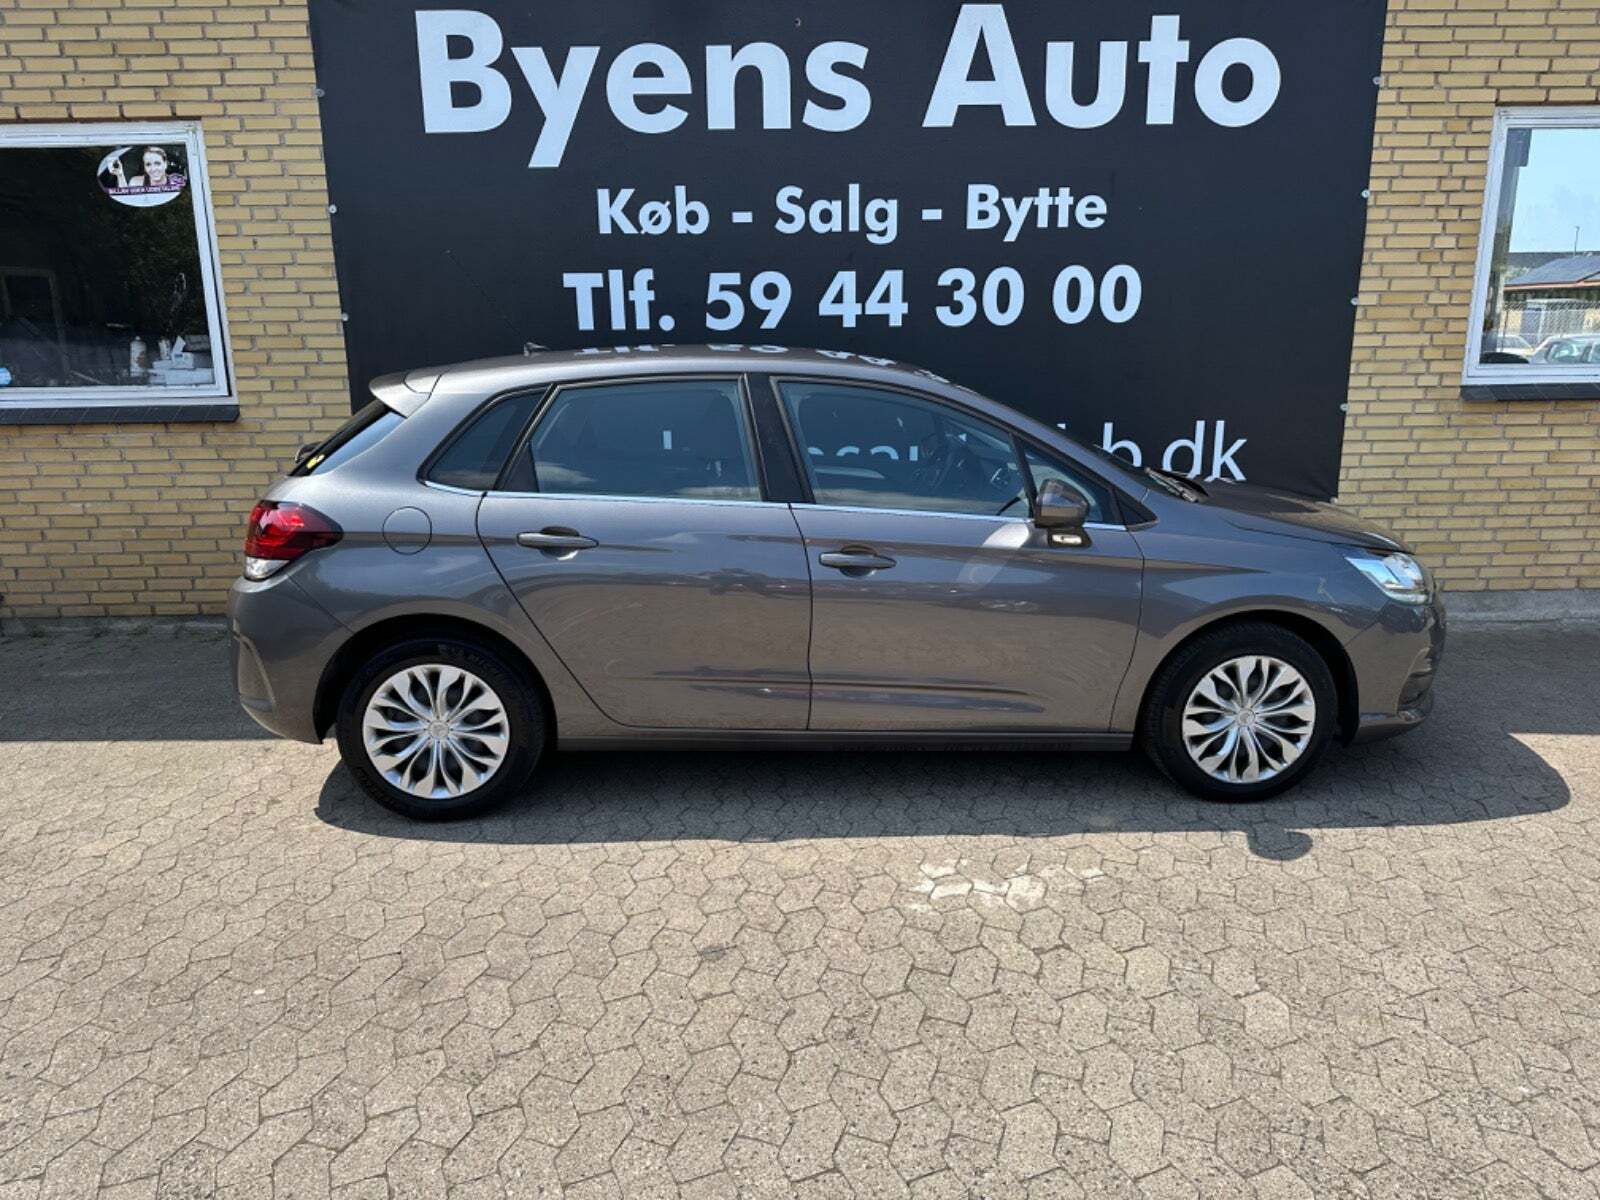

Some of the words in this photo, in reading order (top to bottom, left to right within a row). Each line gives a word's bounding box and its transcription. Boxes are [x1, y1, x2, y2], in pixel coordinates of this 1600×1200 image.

[414, 9, 872, 169] Byens
[921, 3, 1282, 129] Auto
[596, 185, 710, 235] Køb
[774, 183, 898, 245] Salg
[966, 183, 1108, 243] Bytte
[562, 268, 675, 332] Tlf.
[705, 270, 792, 331] 59
[818, 269, 909, 328] 44
[935, 266, 1025, 327] 30
[1052, 264, 1142, 325] 00
